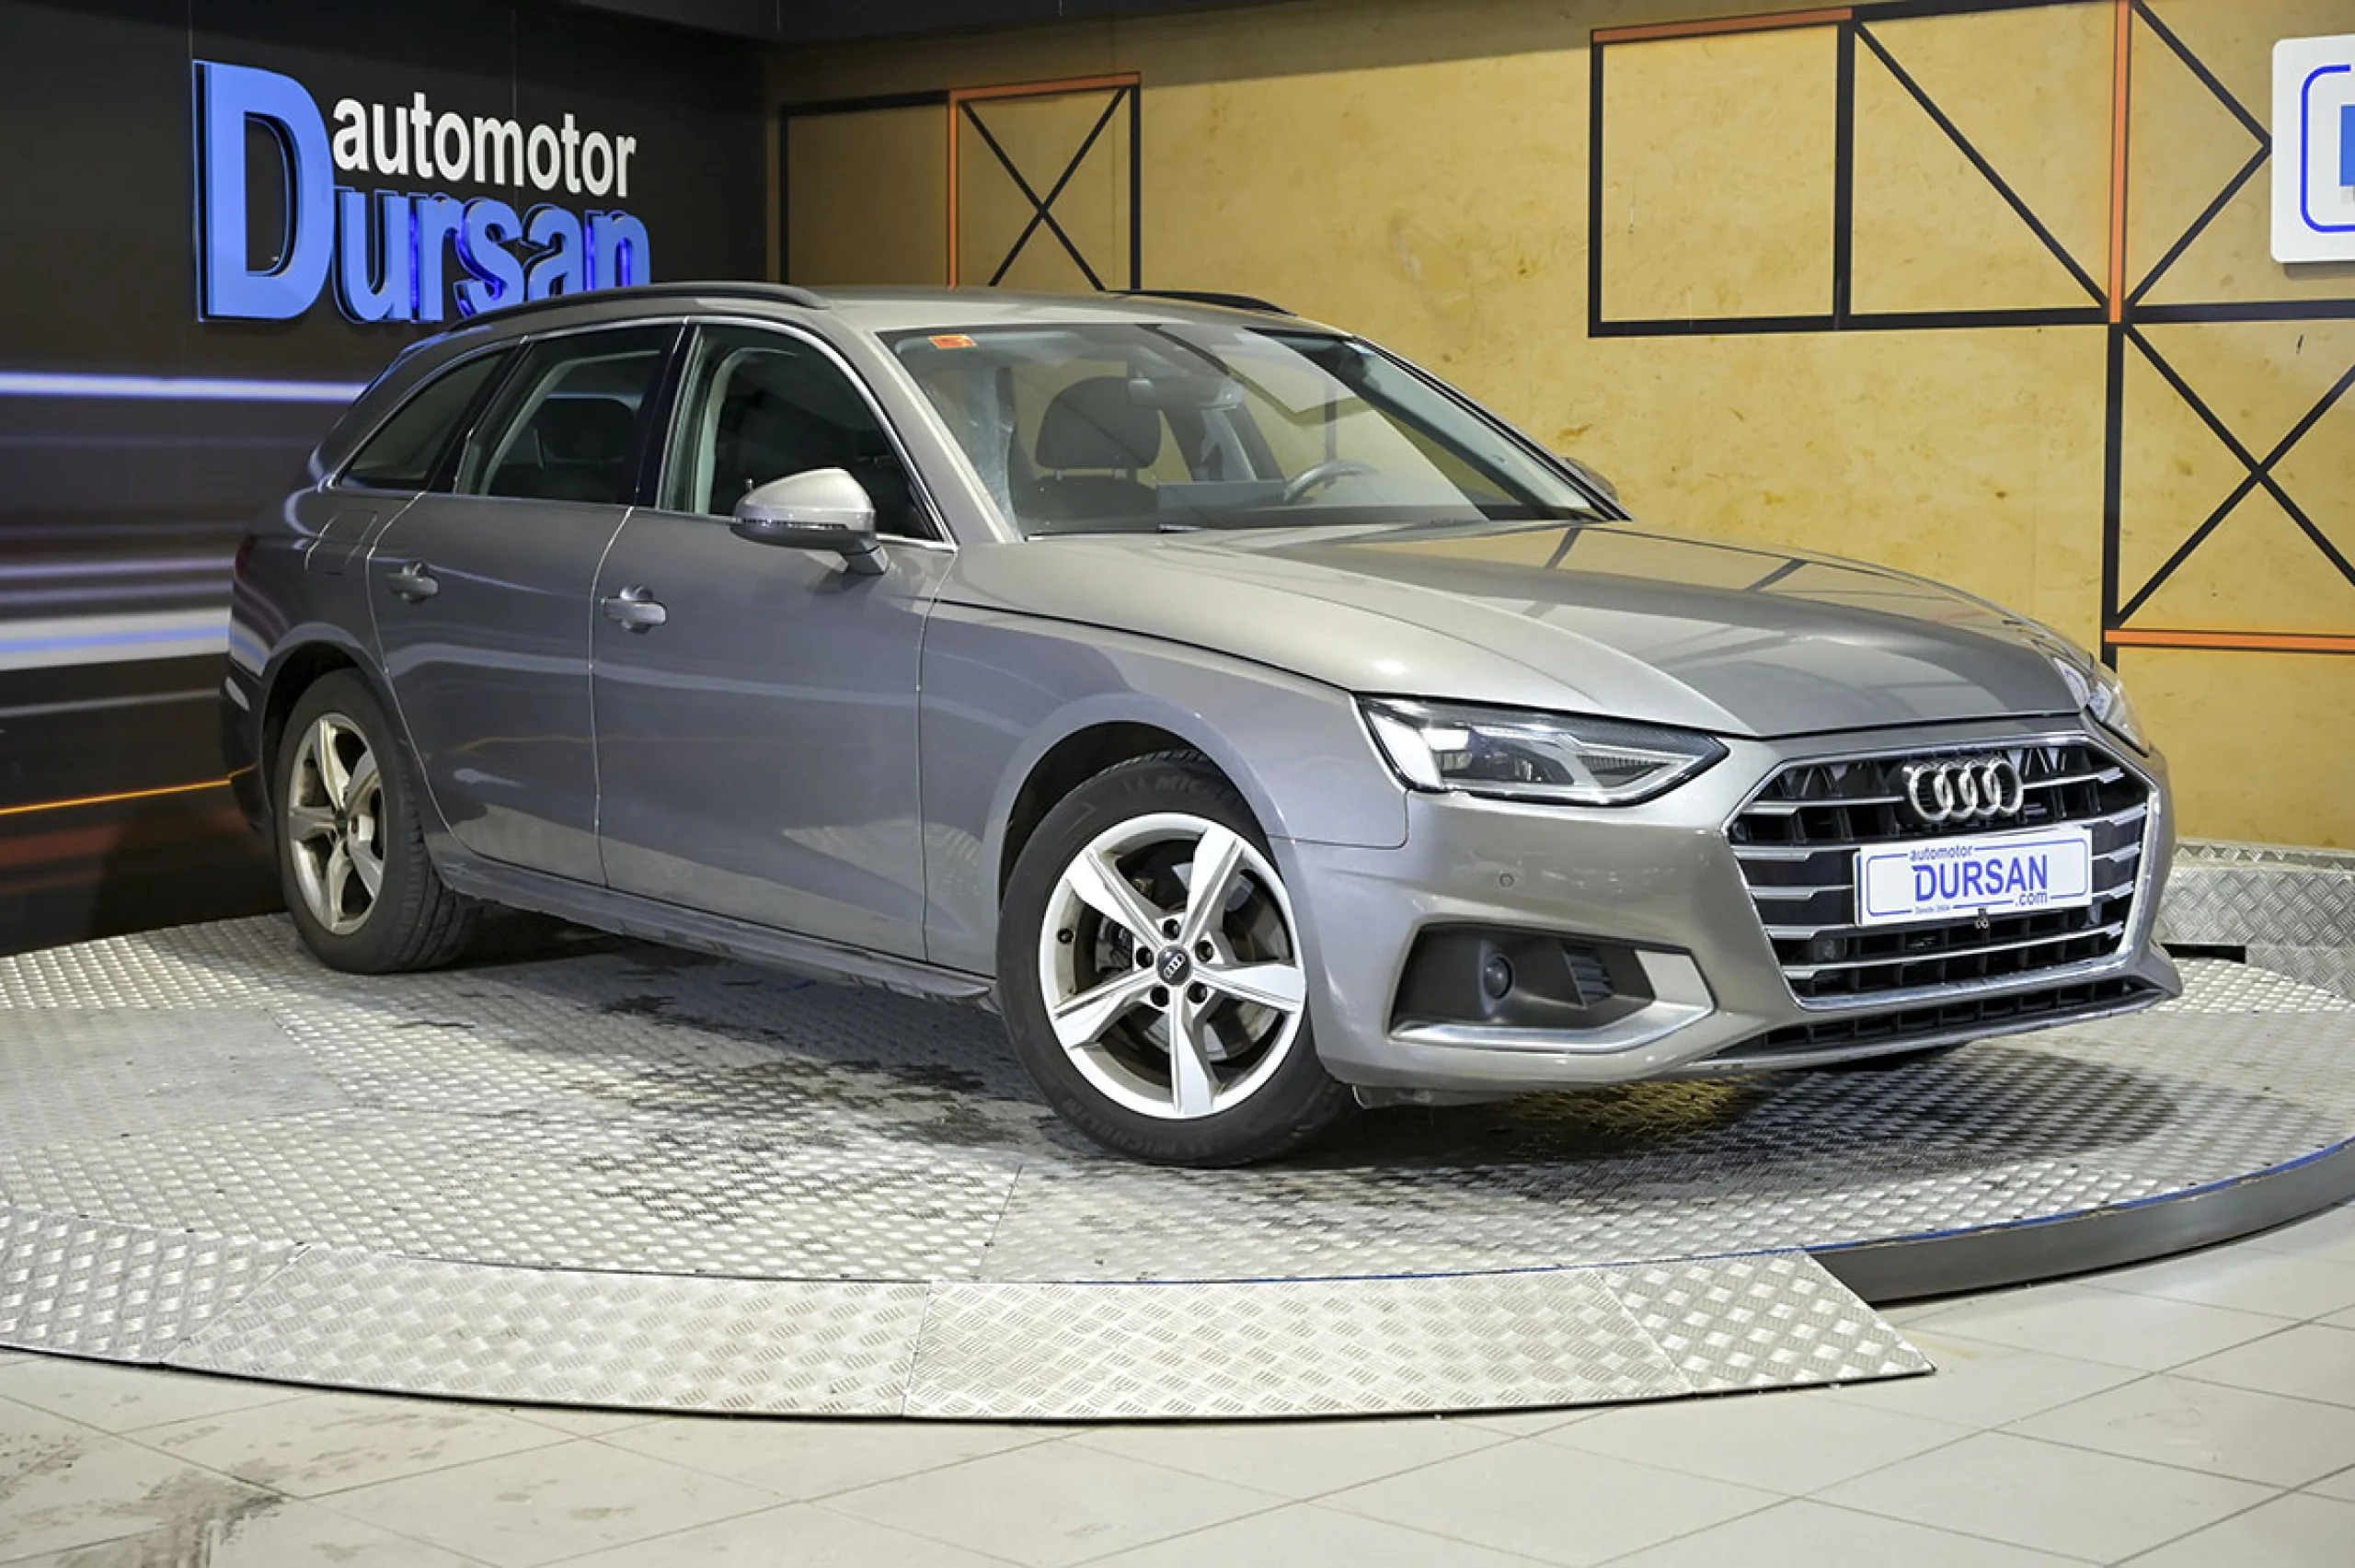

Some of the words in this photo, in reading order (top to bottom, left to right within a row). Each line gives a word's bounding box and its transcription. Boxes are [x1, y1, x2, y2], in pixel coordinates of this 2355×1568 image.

[333, 92, 637, 198] automotor
[192, 59, 650, 323] Dursan
[1910, 844, 1973, 862] automotor
[1912, 854, 2048, 901] DURSAN
[2015, 891, 2048, 907] .com
